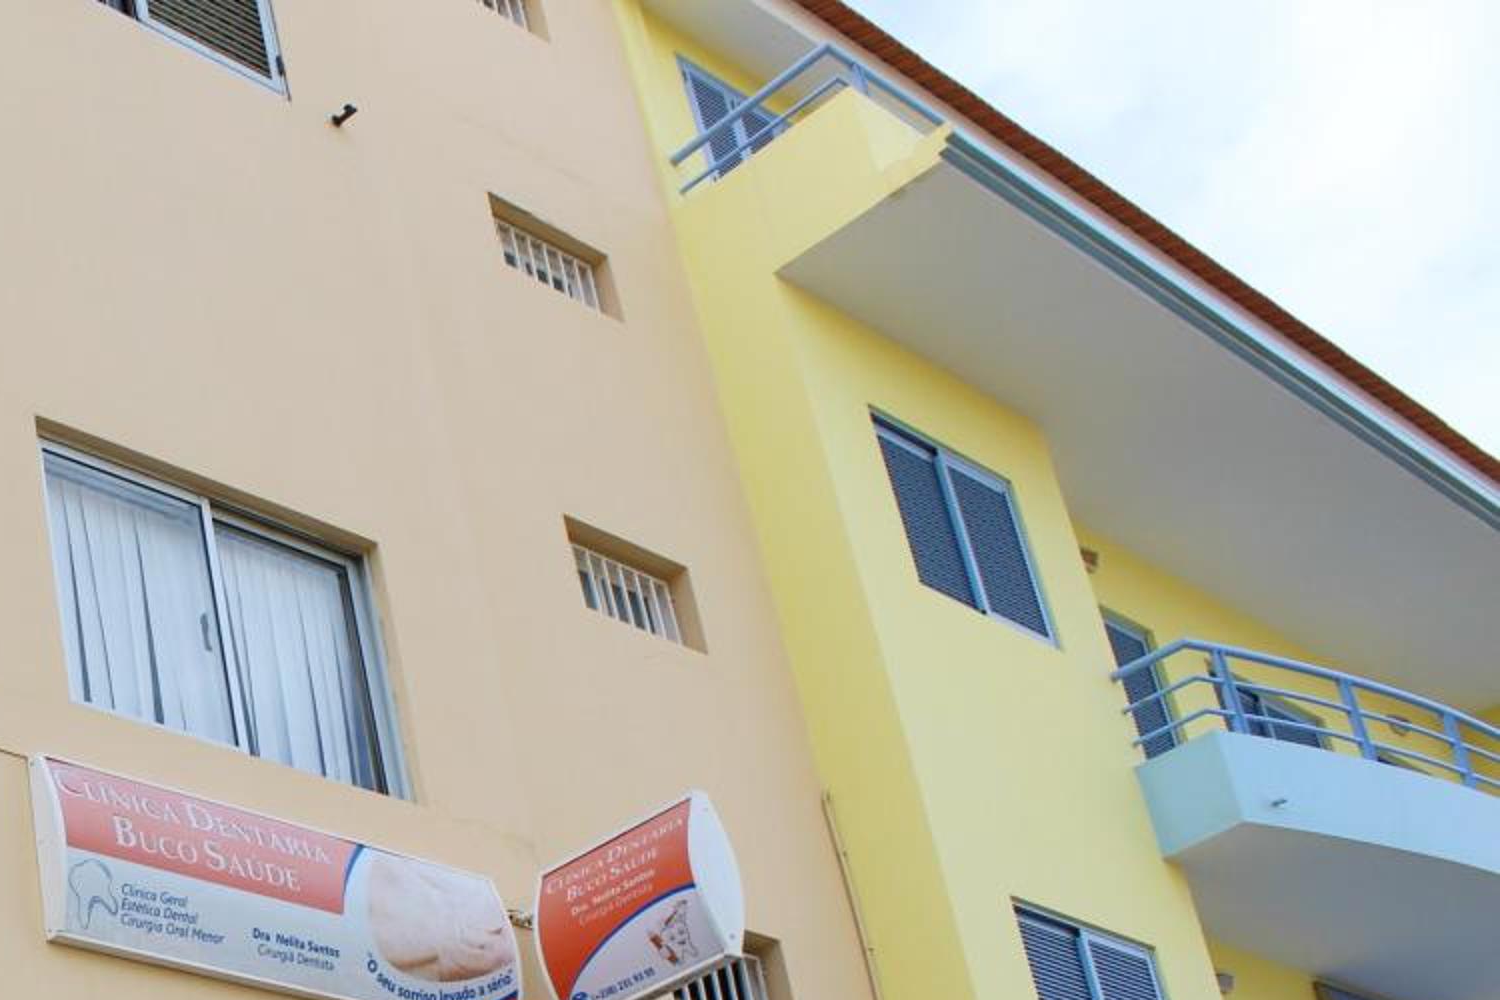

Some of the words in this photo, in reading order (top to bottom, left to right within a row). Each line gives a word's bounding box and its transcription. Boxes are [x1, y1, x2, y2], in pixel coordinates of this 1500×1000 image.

[112, 815, 198, 864] BUCO
[162, 906, 198, 925] Dental
[165, 922, 191, 938] Oral
[190, 926, 227, 945] Menor
[306, 939, 341, 959] Santos
